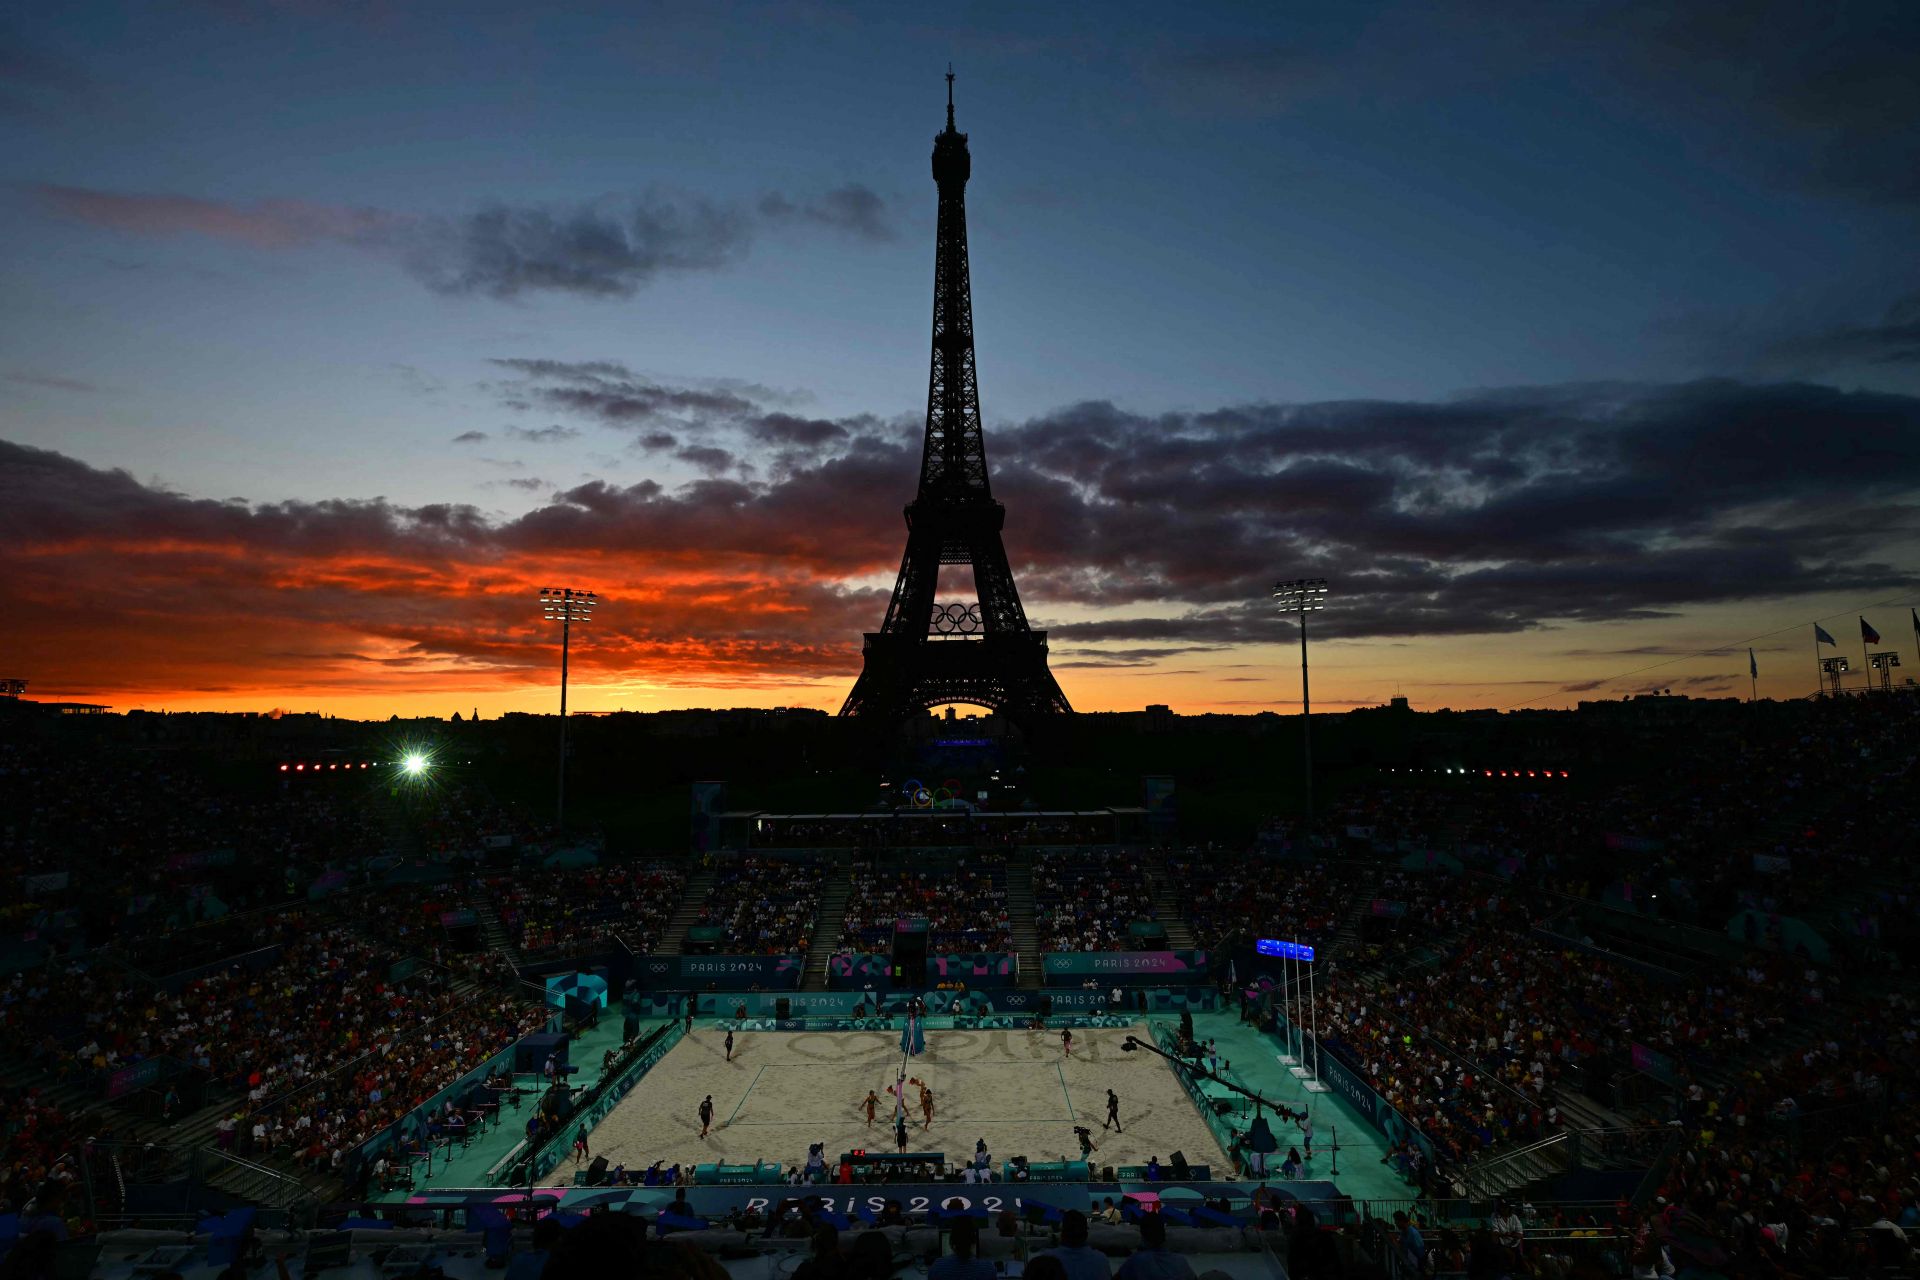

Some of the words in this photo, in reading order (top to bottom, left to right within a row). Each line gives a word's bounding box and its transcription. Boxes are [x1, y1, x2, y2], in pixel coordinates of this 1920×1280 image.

[690, 963, 726, 971] PARIS
[730, 962, 762, 971] 2024
[1094, 959, 1129, 967] PARIS
[1134, 958, 1166, 967] 2024
[770, 998, 806, 1006] PIS
[810, 998, 844, 1006] 2024
[1329, 1066, 1349, 1092] PARIS
[1350, 1085, 1371, 1112] 2024
